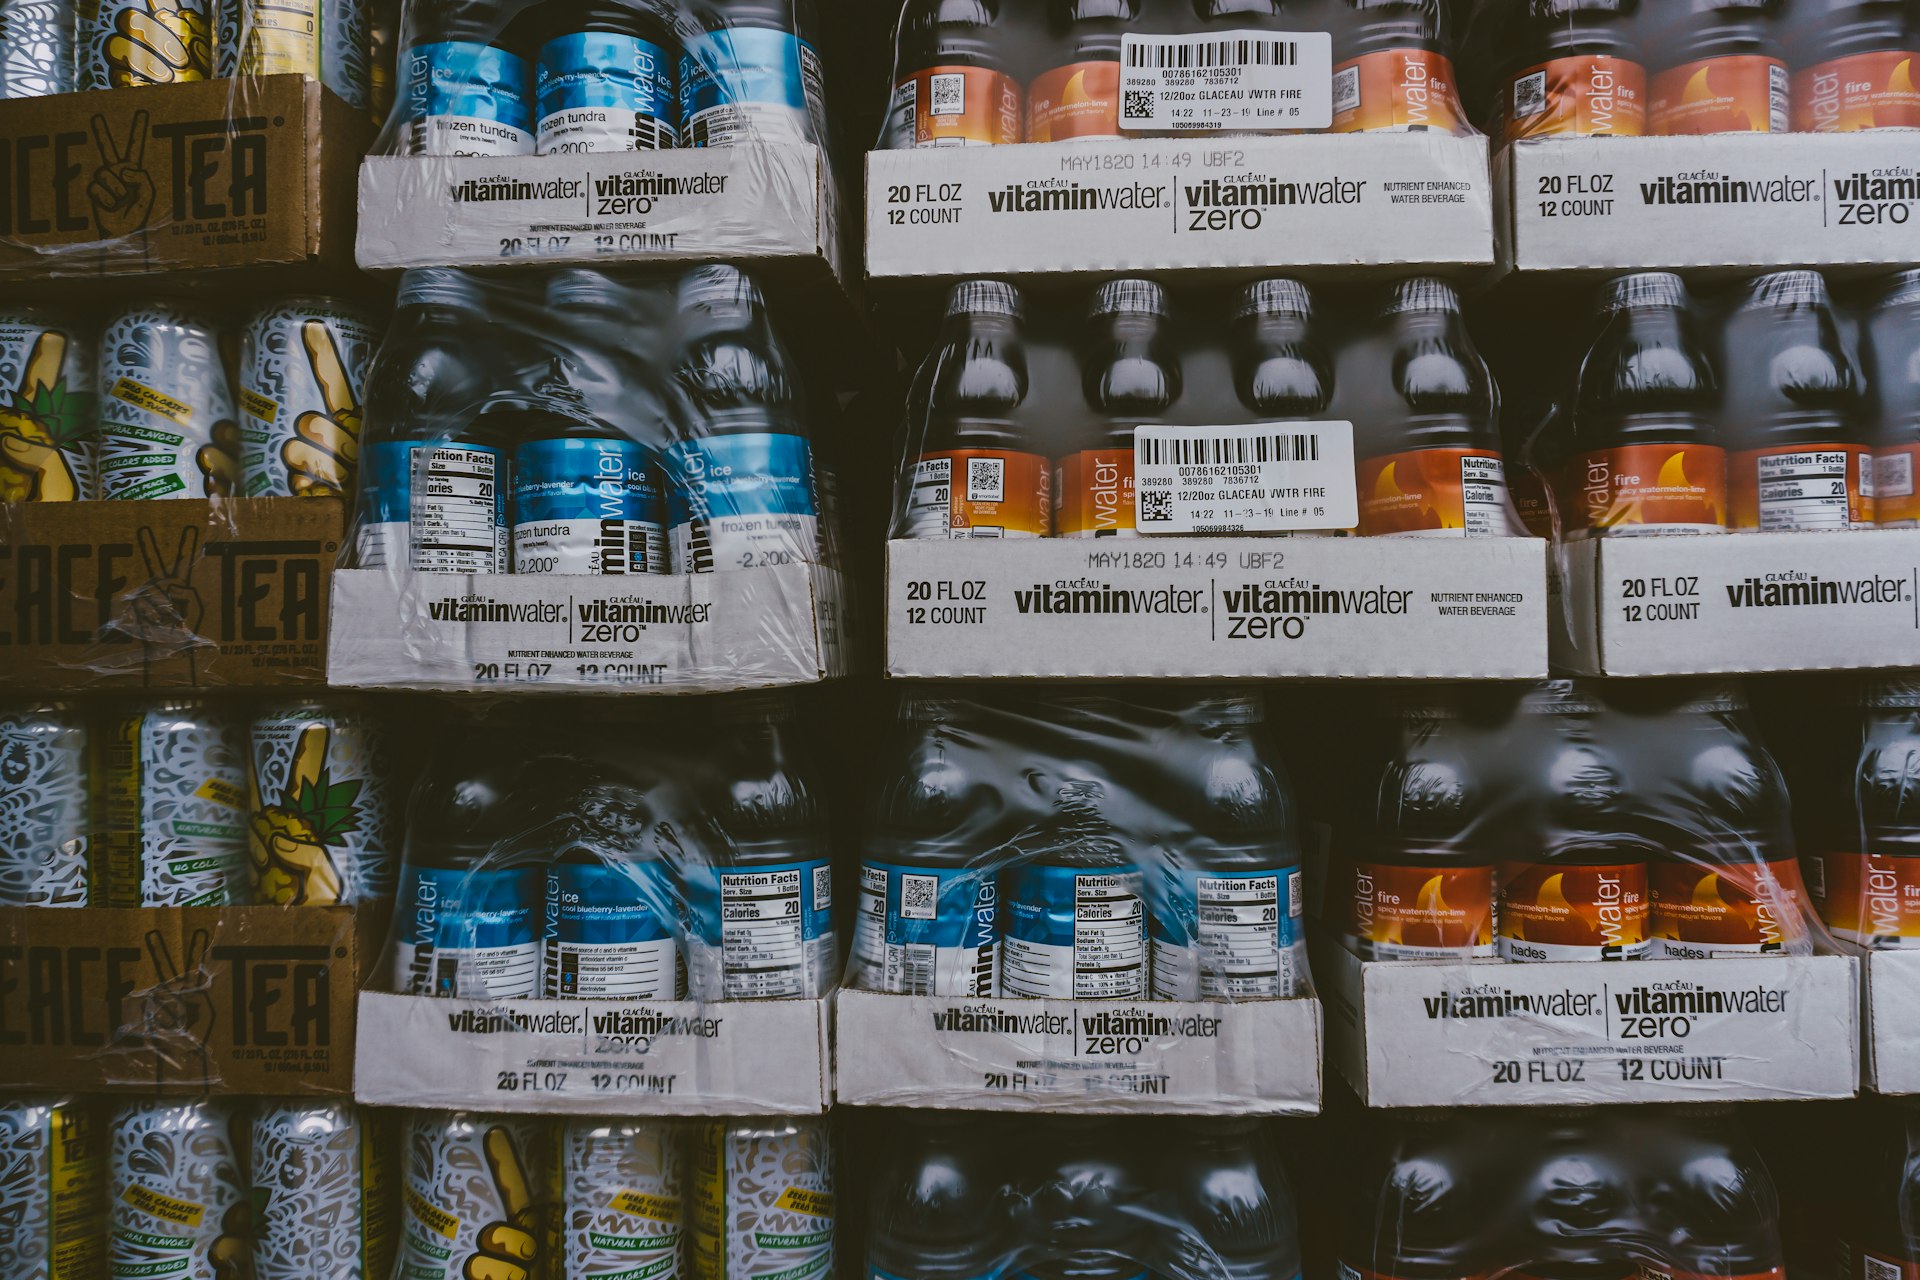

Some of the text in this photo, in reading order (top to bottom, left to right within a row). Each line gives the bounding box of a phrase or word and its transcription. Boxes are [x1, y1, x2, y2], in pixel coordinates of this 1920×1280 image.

[1162, 67, 1242, 78] 00786162105301
[1127, 77, 1239, 86] 389280 389280 7836712
[1430, 77, 1446, 91] fire
[1844, 81, 1872, 94] fire
[1160, 89, 1302, 101] 12/20oz GLACEAU VWTR FIRE
[1617, 85, 1635, 99] fire
[568, 110, 606, 128] tundra
[1171, 108, 1193, 117] 14:22
[1257, 107, 1275, 117] Line
[1289, 107, 1300, 116] 05
[437, 120, 518, 143] frozen tundra
[1061, 150, 1245, 171] MAY1820 14:49 UBF2
[152, 116, 267, 222] TEA
[1384, 181, 1471, 192] NUTRIENT ENHANCED
[1539, 176, 1561, 194] 20
[888, 185, 911, 203] 20
[1391, 193, 1465, 204] WATER BEVERAGE
[1539, 199, 1614, 217] 12 COUNT
[887, 207, 962, 225] 12 COUNT
[134, 428, 180, 444] FLAVORS
[142, 455, 174, 464] ADDED
[1816, 454, 1845, 464] Facts
[628, 468, 646, 482] ice
[710, 464, 732, 477] ice
[1179, 465, 1262, 477] 00786162105301
[1142, 476, 1259, 486] 389280 389280 7836712
[1614, 474, 1640, 486] fire
[1178, 488, 1326, 501] 12/20oz GLACEAU VWTR FIRE
[1831, 481, 1845, 495] 20
[1190, 509, 1214, 519] 14:22
[1281, 507, 1299, 517] Line
[1313, 507, 1324, 517] 05
[1088, 552, 1285, 569] MAY1820 14:49 UBF2
[205, 540, 320, 642] TEA
[907, 581, 931, 601] 20
[1622, 579, 1646, 598] 20
[1431, 593, 1523, 603] NUTRIENT ENHANCED
[906, 607, 987, 624] 12 COUNT
[1438, 606, 1516, 616] WATER BEVERAGE
[1622, 603, 1700, 622] 12 COUNT
[475, 663, 668, 684] 20 12 COUNT
[723, 873, 798, 886] Nutrition Facts
[1199, 880, 1276, 891] Nutrition Facts
[562, 891, 579, 903] ice
[1377, 891, 1400, 905] fire
[1624, 892, 1639, 904] fire
[576, 904, 648, 914] blueberry-lavender
[723, 900, 799, 919] Calories 20
[1077, 908, 1112, 919] Calories
[1511, 943, 1547, 960] hades
[1664, 943, 1704, 959] hades
[1492, 1057, 1727, 1084] 20 FL OZ 12 COUNT
[497, 1072, 612, 1091] 20 12
[593, 1236, 636, 1248] NATURAL
